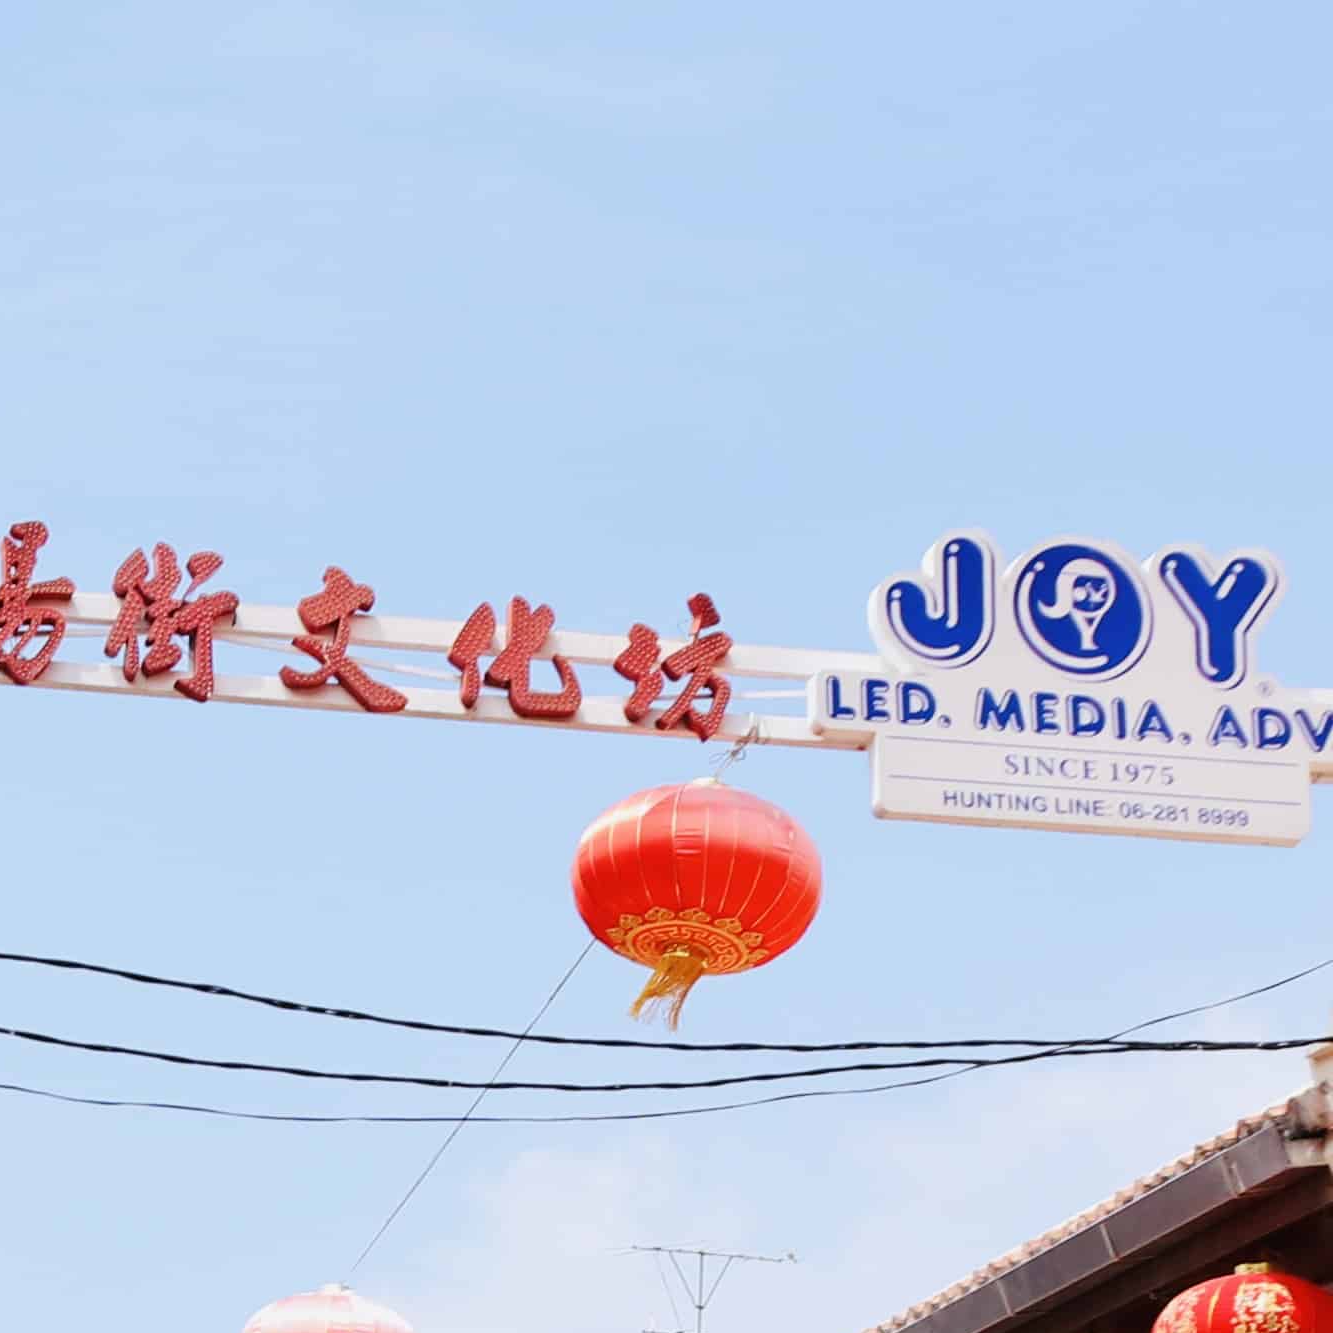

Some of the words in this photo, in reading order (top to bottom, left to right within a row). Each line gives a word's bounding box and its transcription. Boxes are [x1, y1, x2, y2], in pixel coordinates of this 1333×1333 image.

[885, 536, 1269, 684] JOY
[1004, 753, 1099, 782] SINCE
[1109, 759, 1176, 786] 1975
[943, 790, 1049, 814] HUNTING
[1055, 797, 1111, 817] LINE:
[1119, 801, 1190, 824] 06-281
